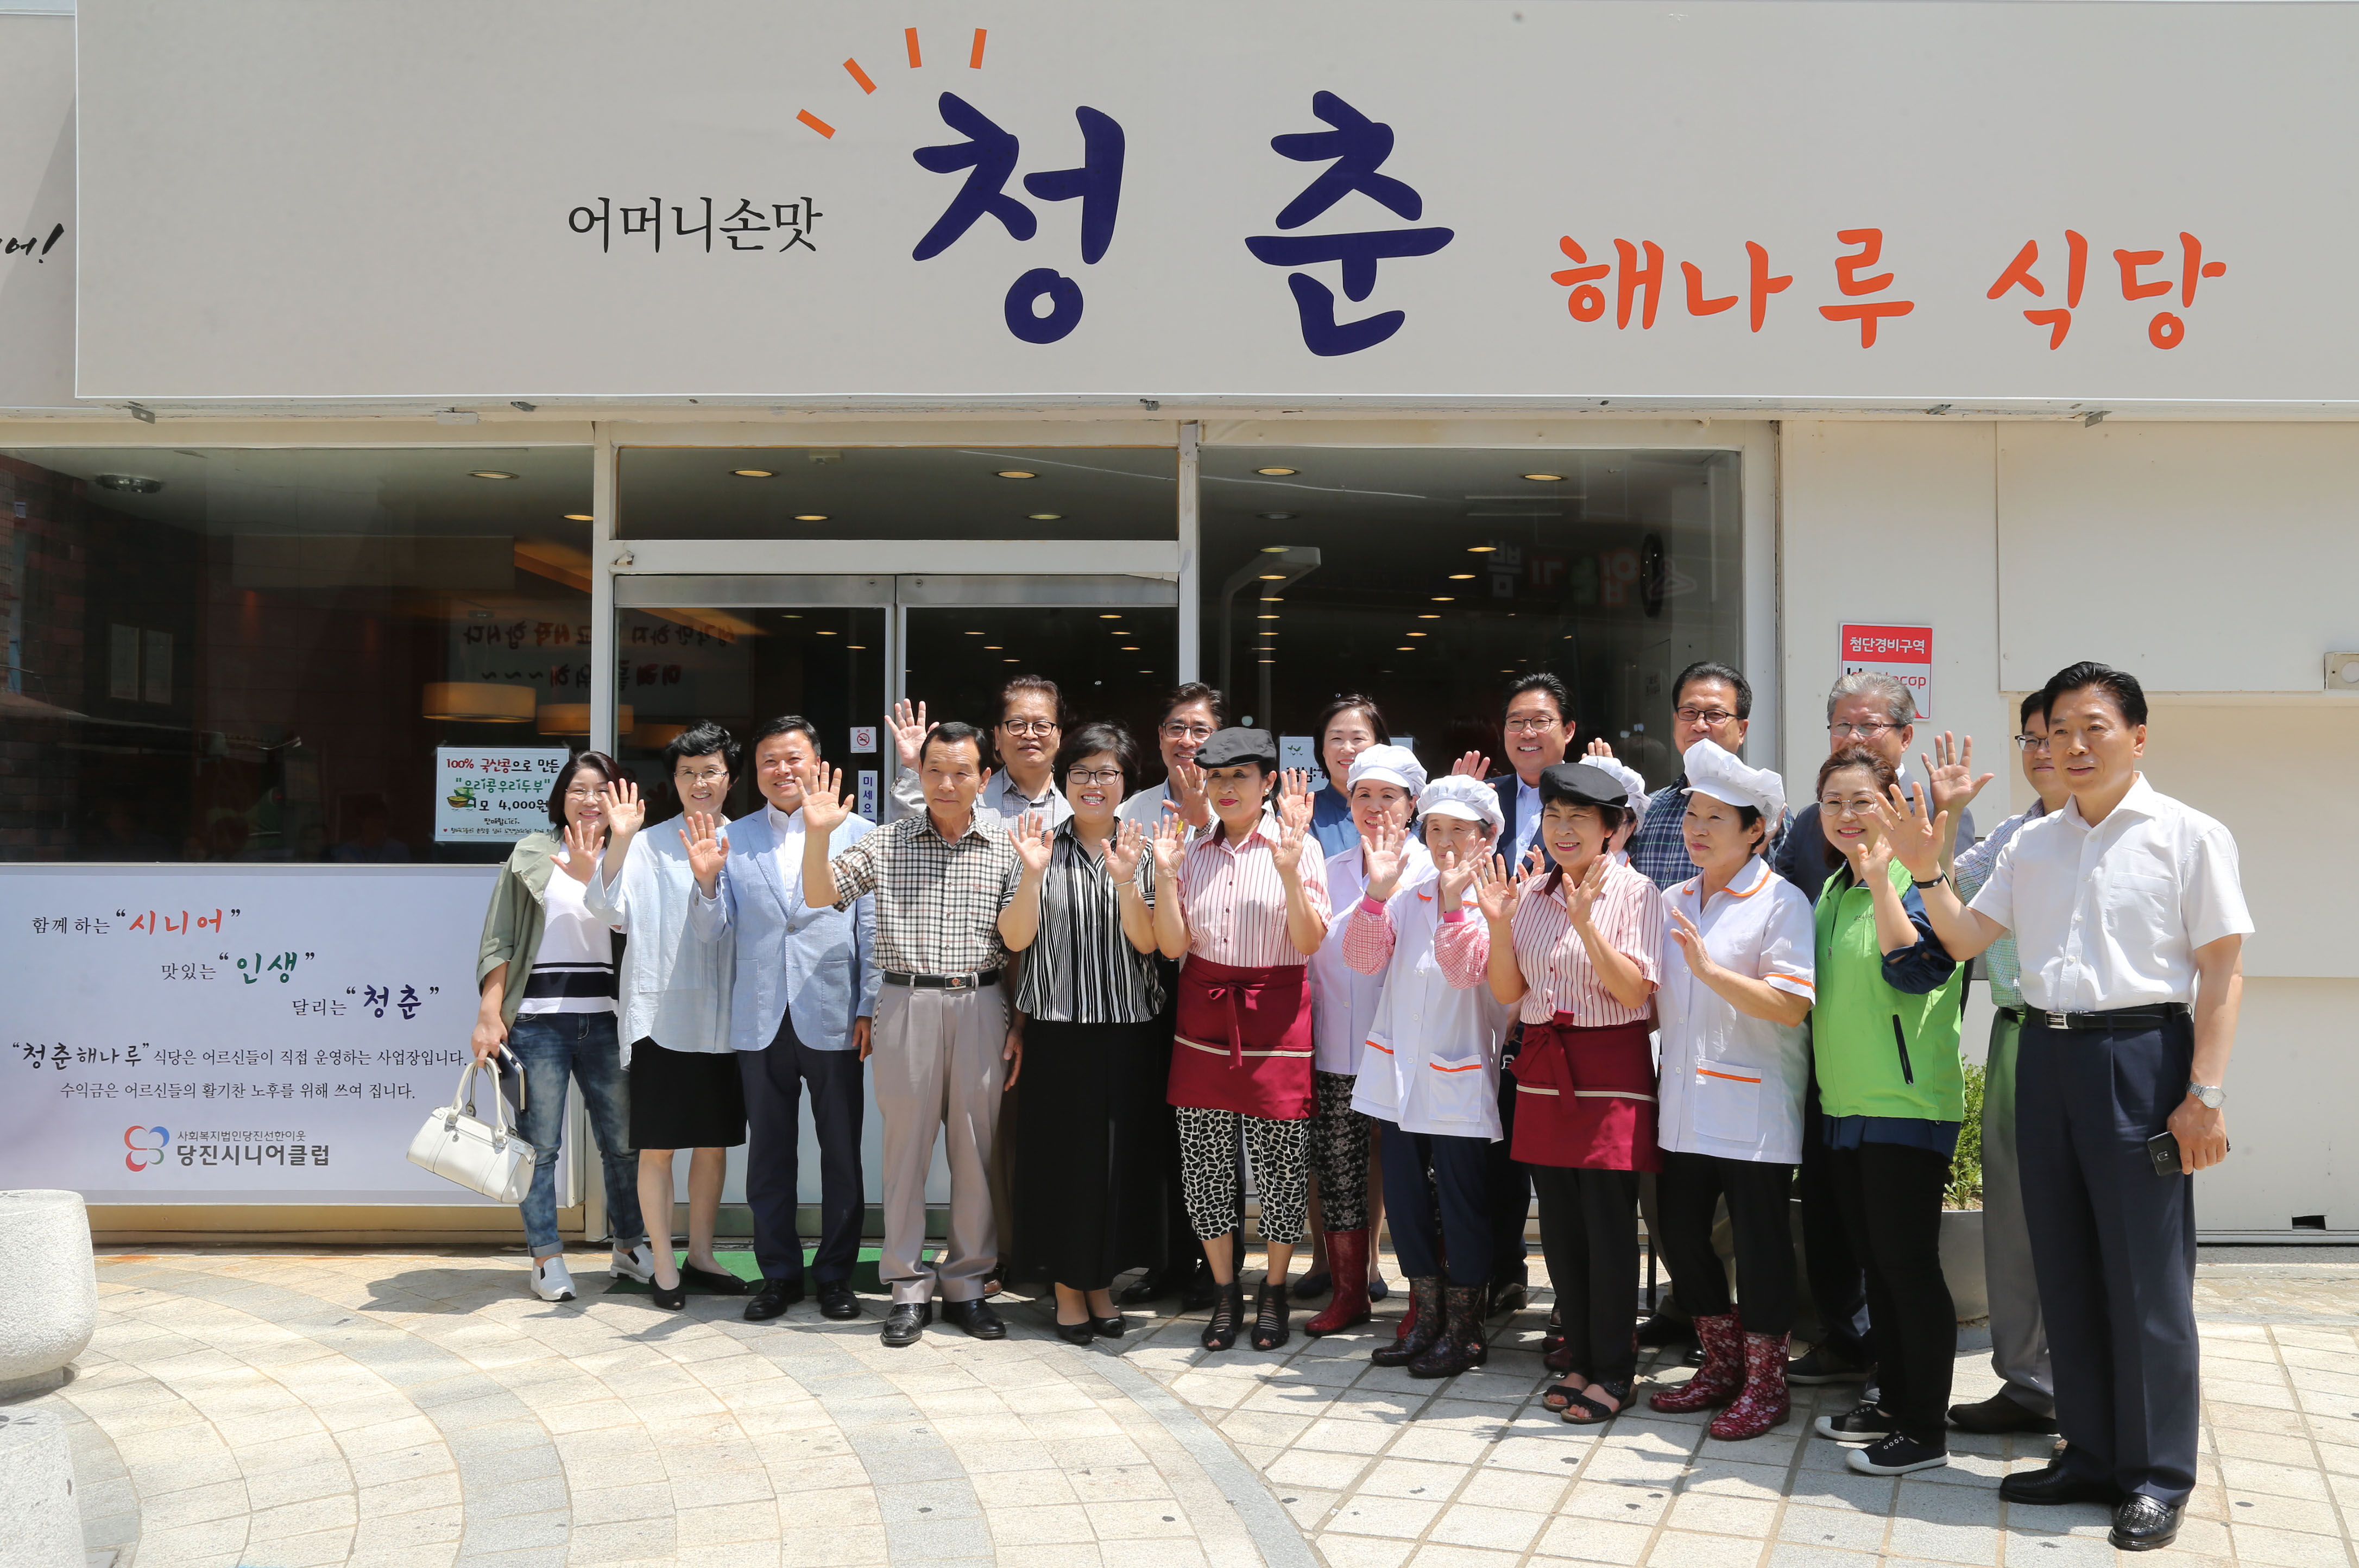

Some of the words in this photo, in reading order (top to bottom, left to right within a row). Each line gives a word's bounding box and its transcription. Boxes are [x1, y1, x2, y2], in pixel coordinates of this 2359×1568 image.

[569, 196, 824, 255] 어머니손맛
[1550, 228, 1916, 350] 해나루
[1986, 229, 2228, 352] 식당
[1849, 637, 1926, 655] 첨단경비구역
[446, 758, 474, 769] 100%
[480, 758, 532, 774] 국산콩으로
[538, 759, 560, 774] 만든
[863, 776, 873, 813] 미세요
[484, 818, 520, 826] 판매합니다.
[33, 916, 68, 935] 함께
[74, 917, 110, 935] 하는
[161, 963, 217, 981] 맛있는
[292, 998, 346, 1017] 달리는
[153, 1049, 197, 1066] 식당은
[202, 1049, 273, 1066] 어르신들이
[280, 1049, 308, 1066] 직접
[313, 1049, 372, 1067] 운영하는
[377, 1049, 468, 1067] 사업장입니다.
[60, 1082, 119, 1099] 수익금은
[124, 1082, 197, 1099] 어르신들의
[201, 1082, 246, 1100] 활기찬
[253, 1082, 295, 1100] 노후를
[300, 1082, 329, 1099] 위해
[334, 1082, 362, 1099] 쓰여
[369, 1082, 416, 1100] 집니다.
[176, 1145, 330, 1167] 당진시니어클럽
